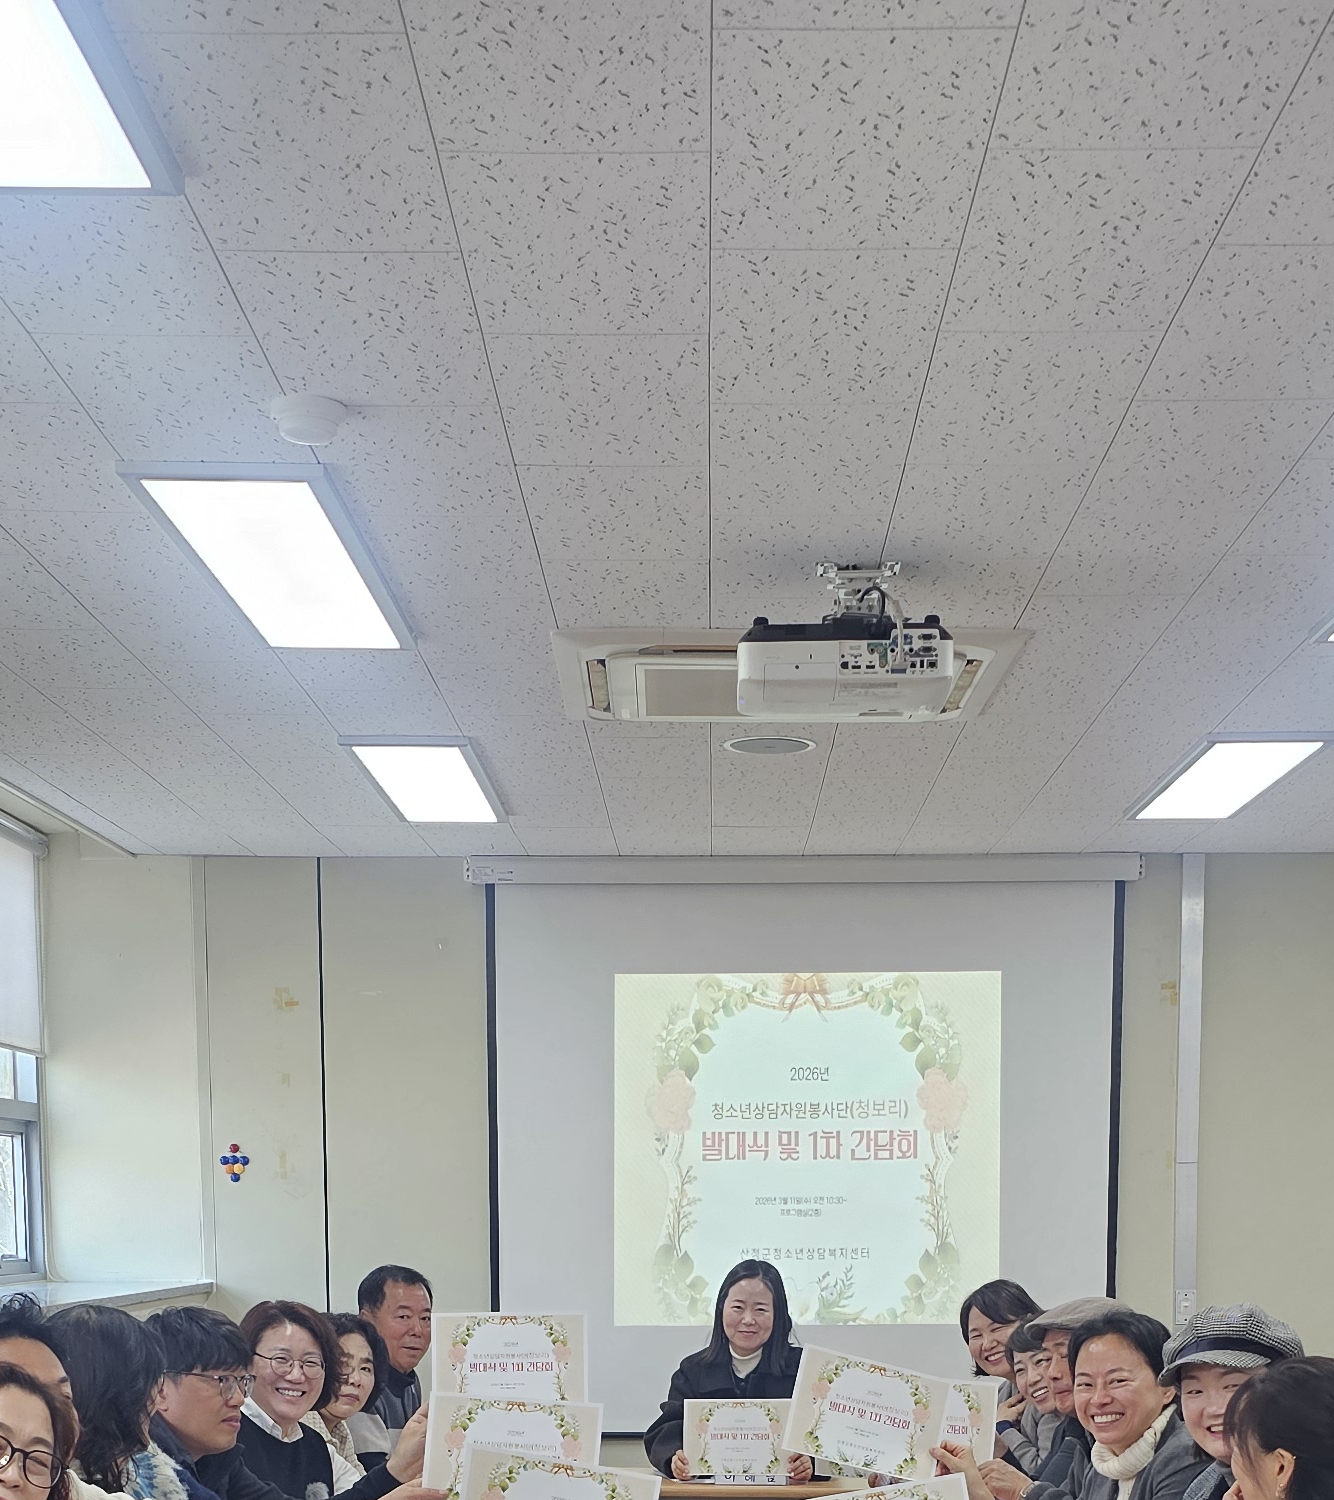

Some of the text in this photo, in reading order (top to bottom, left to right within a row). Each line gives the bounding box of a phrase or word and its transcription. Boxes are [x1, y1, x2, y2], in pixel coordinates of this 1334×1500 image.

[790, 1066, 829, 1082] 2026년
[711, 1099, 909, 1120] 청소년상담자원봉사단(청보리)
[701, 1129, 918, 1162] 발대식 및 1차 간담회
[739, 1247, 870, 1260] 산청군청소년상담복지센터
